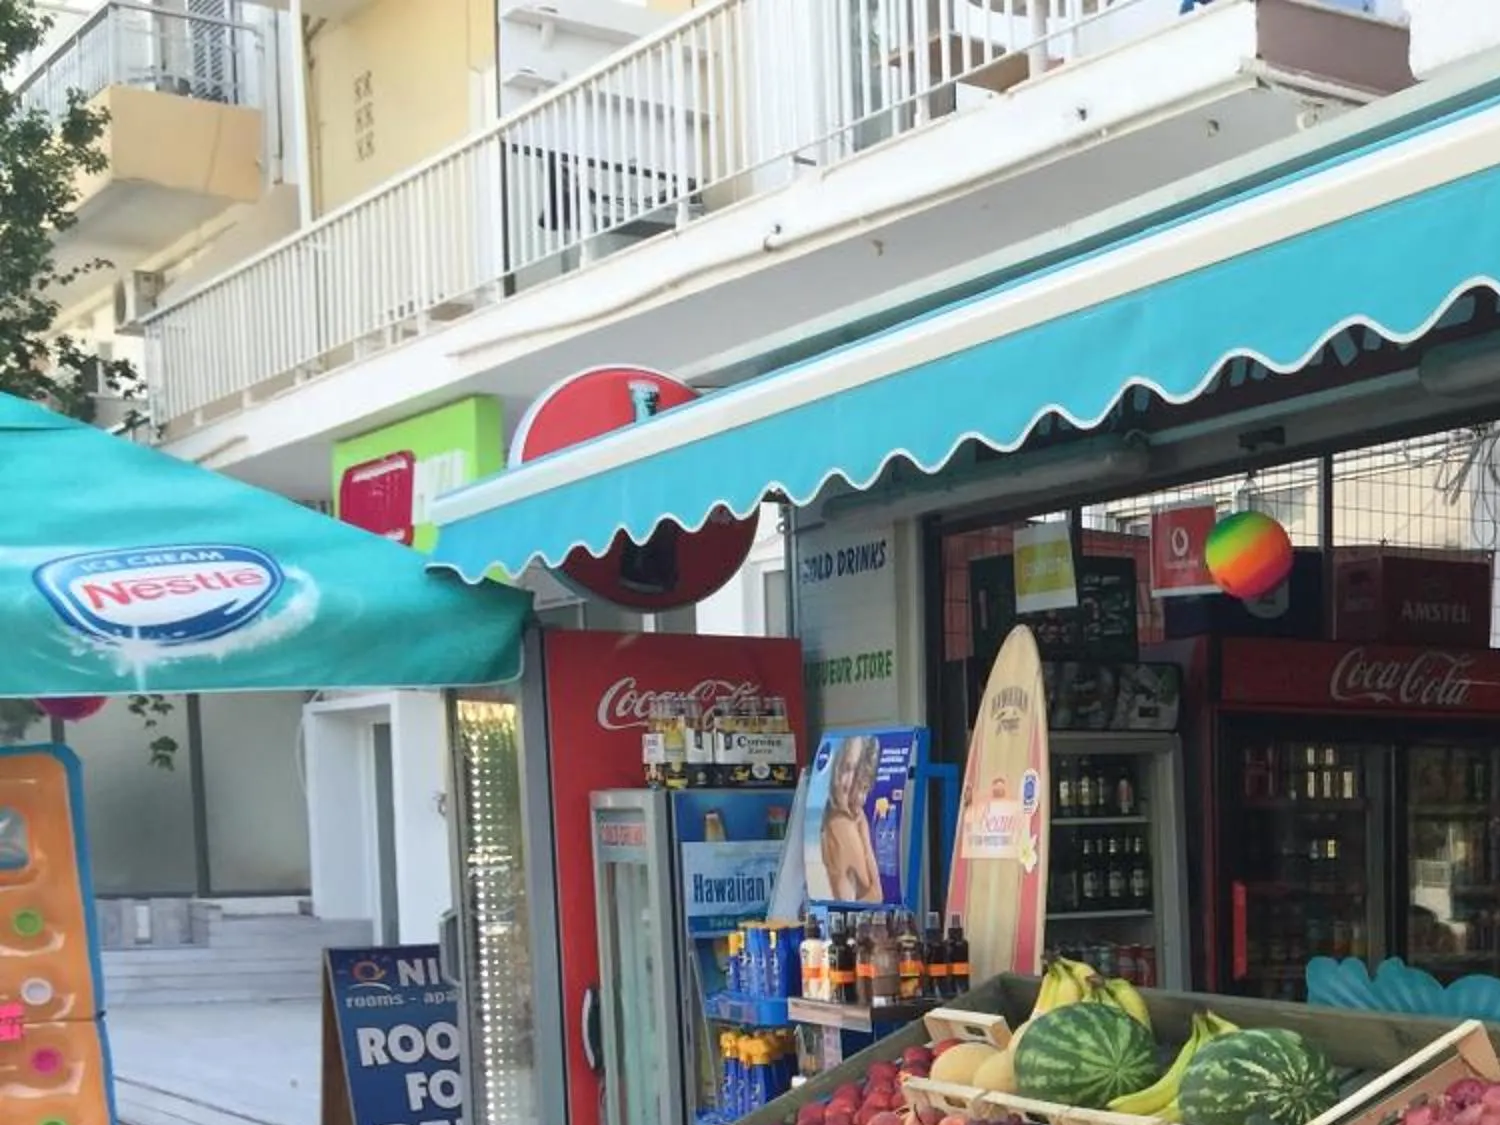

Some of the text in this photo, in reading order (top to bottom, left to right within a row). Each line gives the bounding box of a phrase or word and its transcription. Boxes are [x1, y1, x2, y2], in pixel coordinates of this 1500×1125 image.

[80, 550, 226, 573] ICE CREAM
[837, 540, 887, 577] DRINKS
[1401, 601, 1471, 624] AMSTEL
[855, 650, 894, 682] STORE
[693, 871, 766, 904] Hawaiian
[397, 957, 440, 987] NI
[356, 1021, 461, 1067] ROO
[405, 1068, 462, 1112] FO
